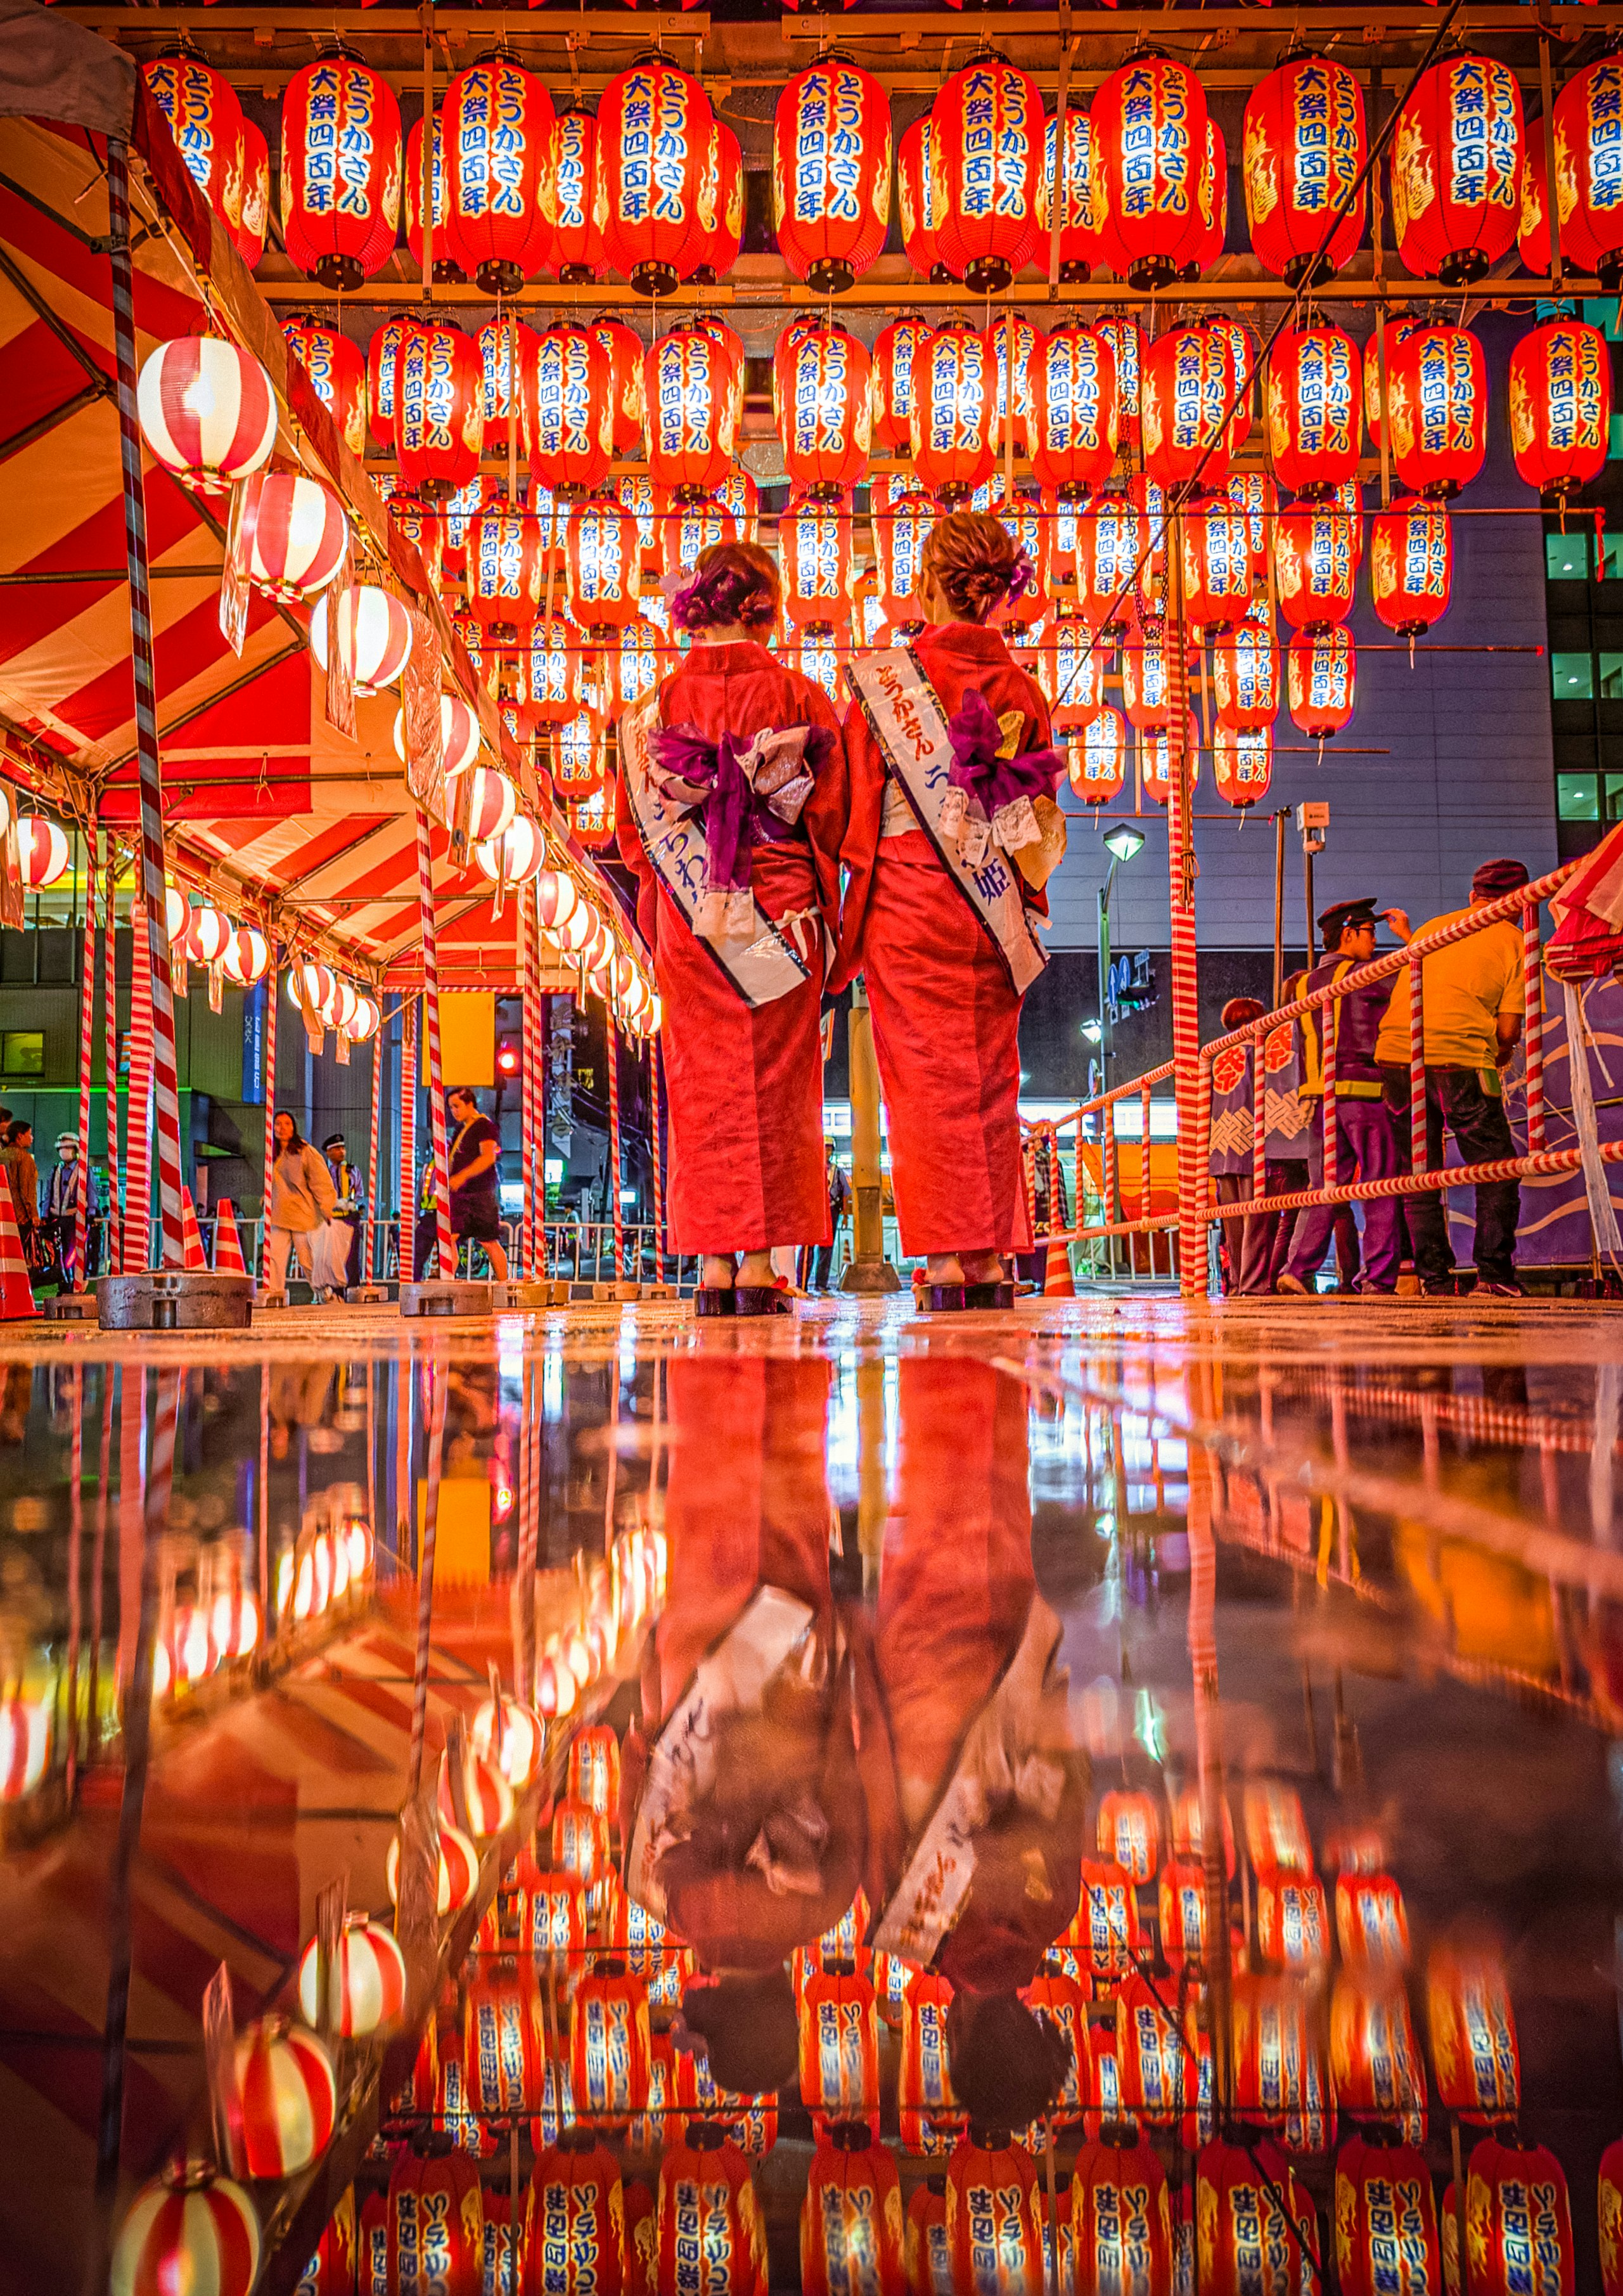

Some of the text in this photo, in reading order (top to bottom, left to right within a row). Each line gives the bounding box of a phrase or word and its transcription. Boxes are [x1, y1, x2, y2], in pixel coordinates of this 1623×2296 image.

[309, 68, 337, 211] 大祭四百年
[342, 69, 371, 215] とうかさん
[462, 72, 489, 214] 大祭四百年
[496, 69, 523, 212] とうかさん
[560, 117, 583, 224] とうかさん
[622, 75, 651, 219] 大祭四百年
[656, 75, 686, 218] とうかさん
[798, 74, 828, 218] 大祭四百年
[831, 73, 861, 217] とうかさん
[963, 72, 995, 214] 大祭四百年
[998, 72, 1028, 216] とうかさん
[1074, 117, 1093, 226] とうかさん
[1124, 70, 1154, 214] 大祭四百年
[1160, 67, 1187, 212] とうかさん
[1297, 67, 1328, 210] 大祭四百年
[1454, 63, 1485, 202] 大祭四百年
[1492, 64, 1515, 205] とうかさん
[404, 335, 425, 449] 大祭四百年
[428, 335, 451, 448] とうかさん
[540, 339, 561, 452] 大祭四百年
[566, 339, 589, 450] とうかさん
[662, 341, 683, 452] 大祭四百年
[687, 340, 711, 451] とうかさん
[798, 341, 819, 452] 大祭四百年
[823, 339, 847, 450] とうかさん
[933, 339, 955, 449] 大祭四百年
[961, 339, 981, 449] とうかさん
[1049, 340, 1070, 449] 大祭四百年
[1077, 337, 1098, 448] とうかさん
[1178, 335, 1202, 448] 大祭四百年
[1300, 339, 1323, 452] 大祭四百年
[1329, 338, 1349, 451] とうかさん
[1421, 339, 1448, 452] 大祭四百年
[1453, 335, 1473, 449] とうかさん
[1549, 334, 1574, 449] 大祭四百年
[1580, 333, 1600, 447] とうかさん
[876, 666, 934, 761] とうかさん
